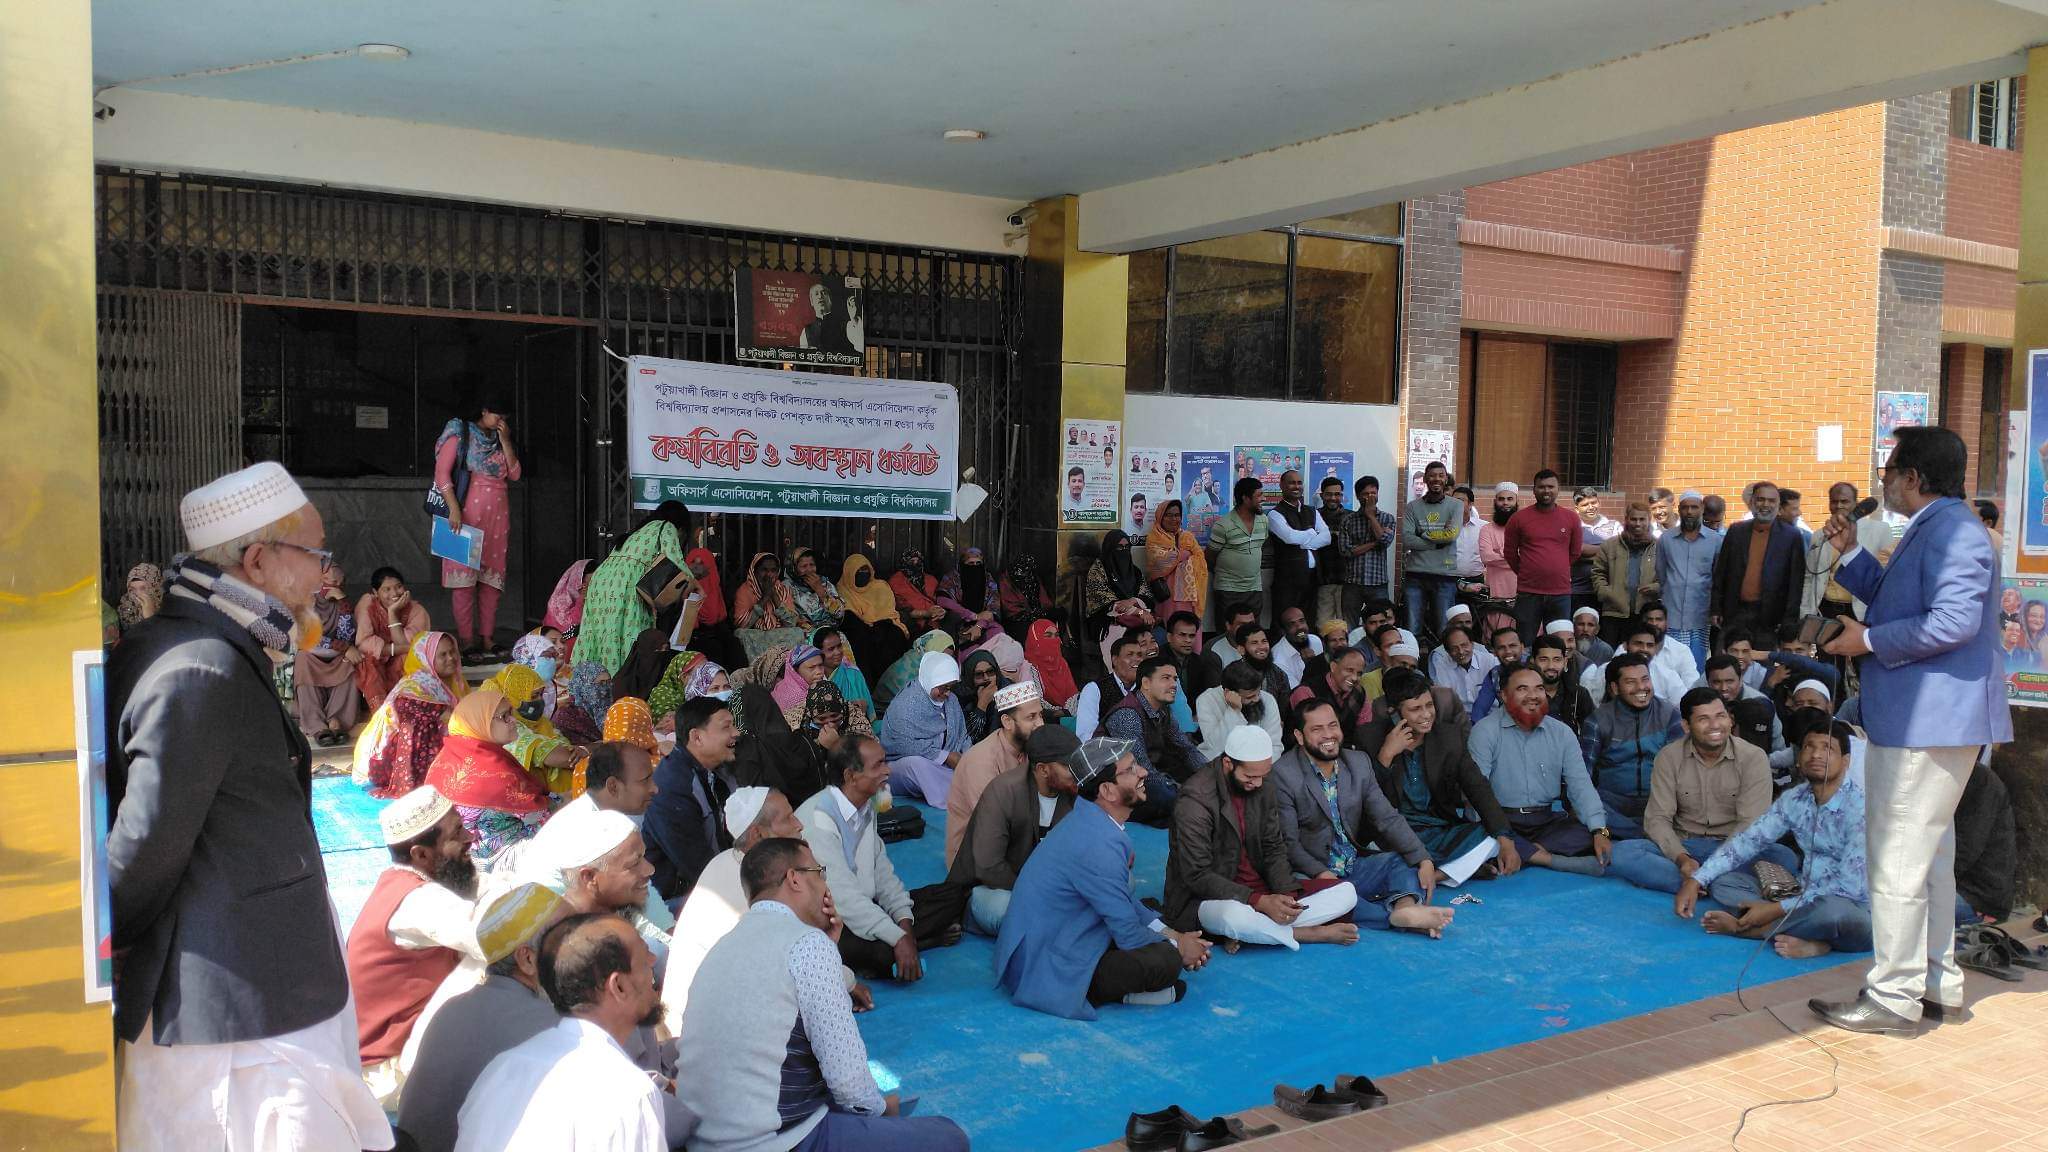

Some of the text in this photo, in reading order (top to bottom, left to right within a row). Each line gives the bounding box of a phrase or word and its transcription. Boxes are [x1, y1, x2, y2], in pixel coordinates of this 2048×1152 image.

[655, 382, 938, 420] পটুয়াখালী বিজ্ঞান ও প্রযুক্তি বিশ্ববিদ্যালয়ের অফিসার্স এসোসিয়েশন কর্তৃক
[656, 399, 935, 431] বিশ্ববিদ্যালয় প্রশাসনের নিকট পেশকৃত দাবী সমূহ আদায় না হওয়া পর্যন্ত
[648, 426, 941, 479] কর্মবিরতি ও অবস্থান ধর্মঘট
[667, 484, 709, 499] অফিসার্স
[777, 488, 820, 504] পটুয়াখালী
[822, 489, 851, 505] বিজ্ঞান
[852, 495, 861, 505] ও
[862, 492, 888, 509] প্রযুক্তি
[891, 493, 939, 509] বিশ্ববিদ্যালয়
